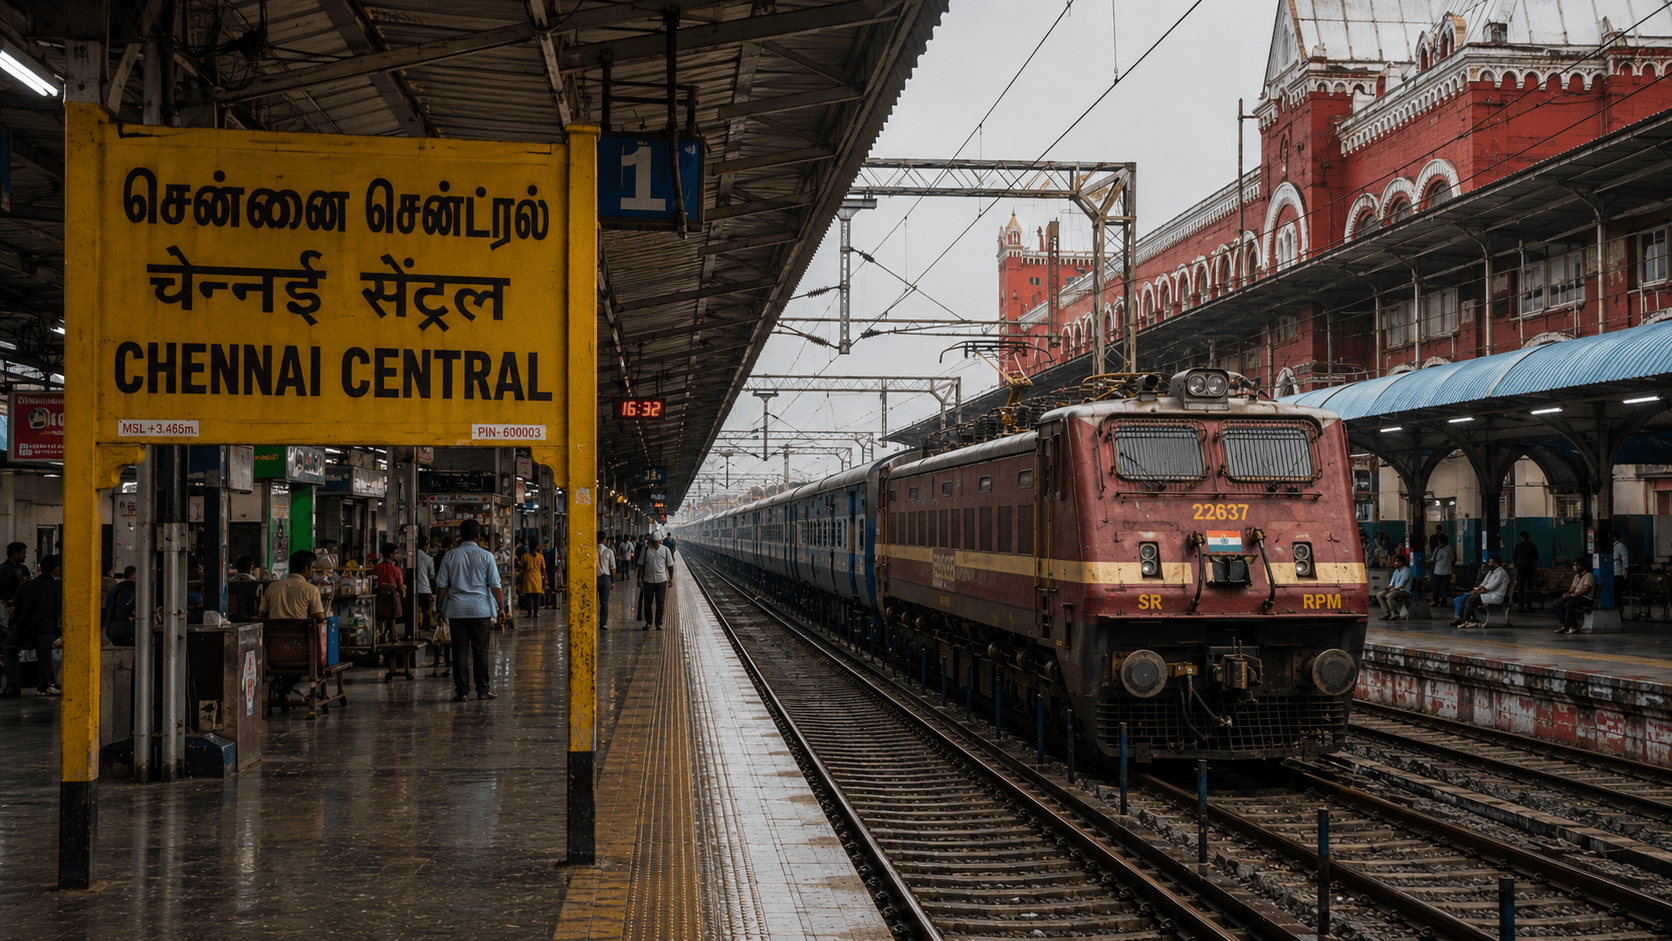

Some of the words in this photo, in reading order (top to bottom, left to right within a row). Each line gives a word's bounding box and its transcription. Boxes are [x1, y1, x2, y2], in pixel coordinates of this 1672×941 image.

[621, 145, 666, 211] 1
[123, 167, 349, 232] சென்னை
[366, 178, 549, 250] சென்ட்ரல்
[146, 245, 327, 326] चेन्नई
[360, 253, 511, 332] सेंट्रल
[115, 341, 321, 397] CHENNAI
[341, 347, 553, 401] CENTRAL
[622, 401, 661, 416] 16:32
[1192, 503, 1250, 520] 22637
[1138, 594, 1162, 610] SR
[1303, 593, 1342, 609] RPM
